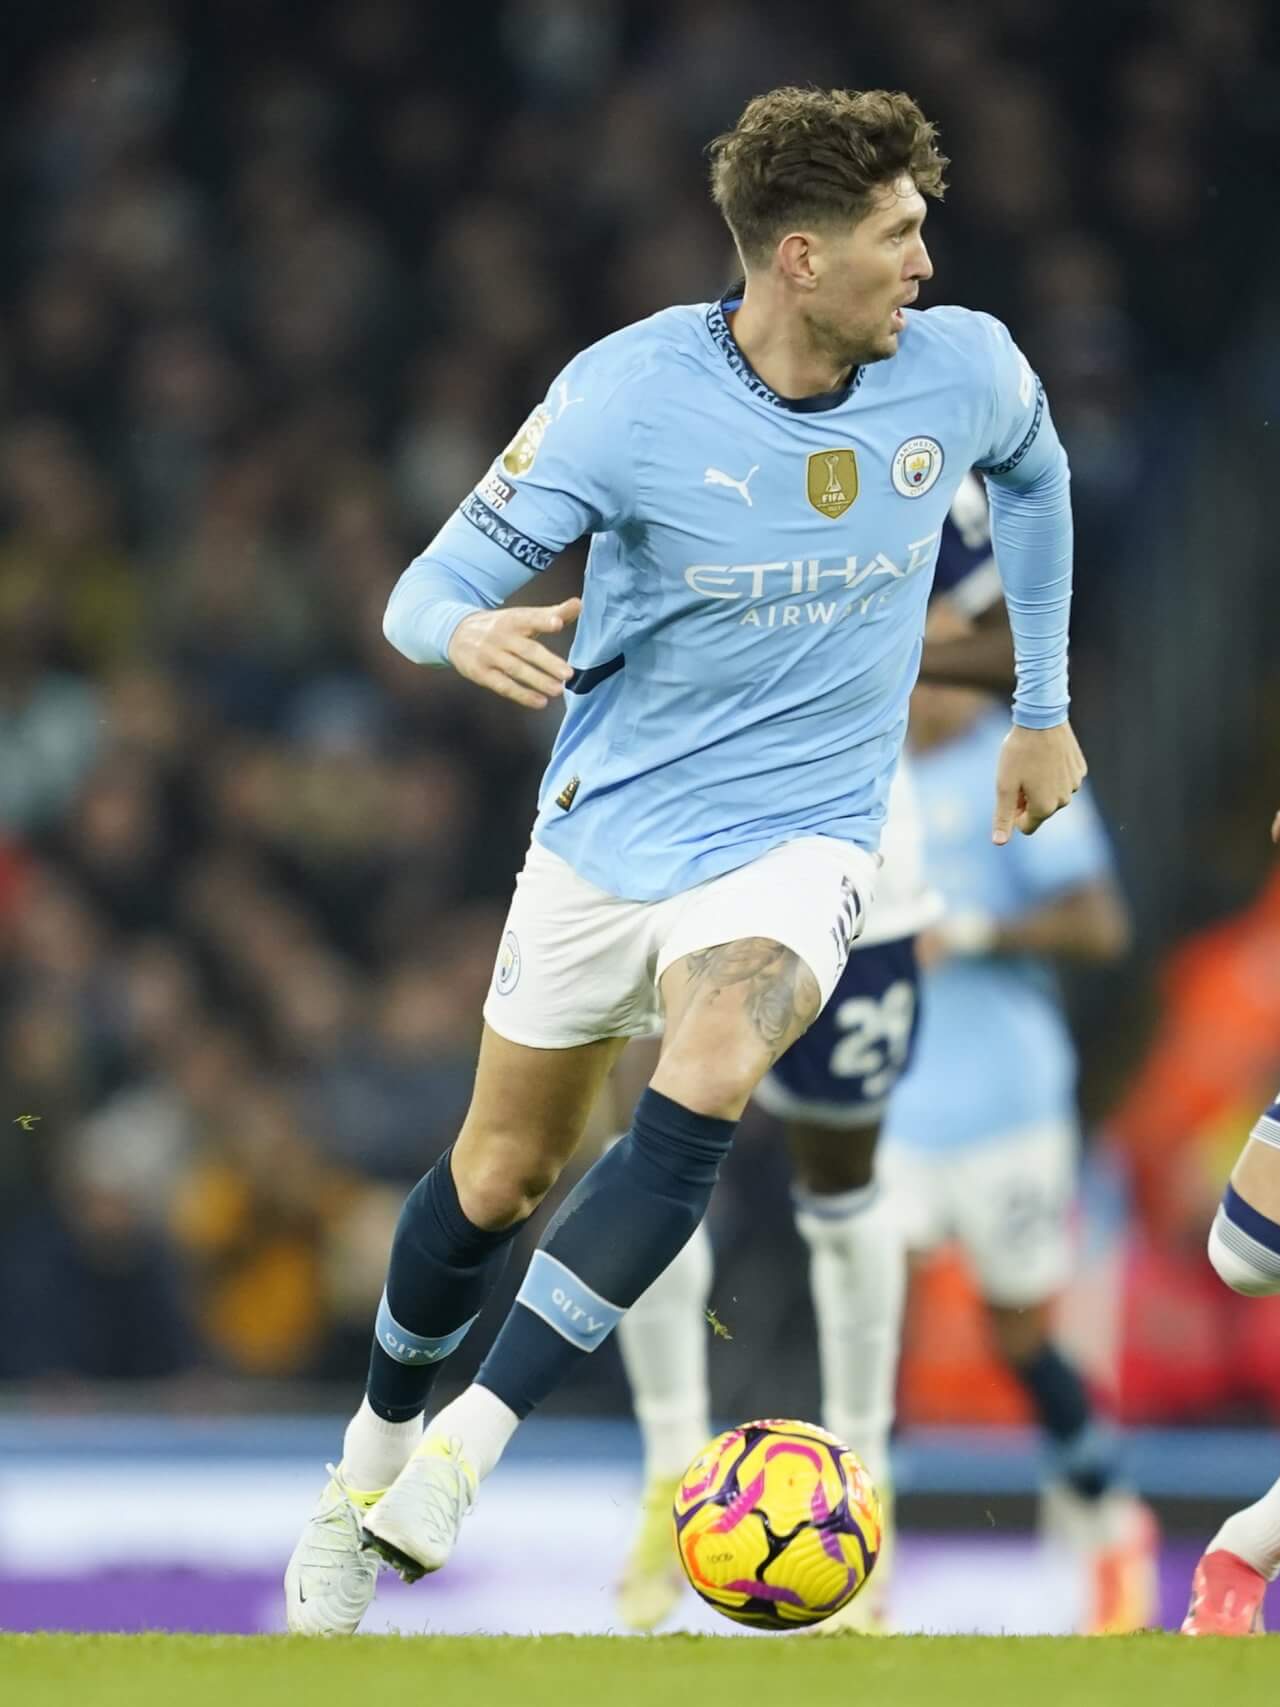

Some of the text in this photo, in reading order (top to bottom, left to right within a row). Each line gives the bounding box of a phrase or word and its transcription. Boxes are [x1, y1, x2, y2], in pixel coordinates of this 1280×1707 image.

[821, 492, 846, 503] FIFA
[829, 978, 915, 1098] 29
[551, 1287, 606, 1334] CITY
[385, 1332, 442, 1361] CITY
